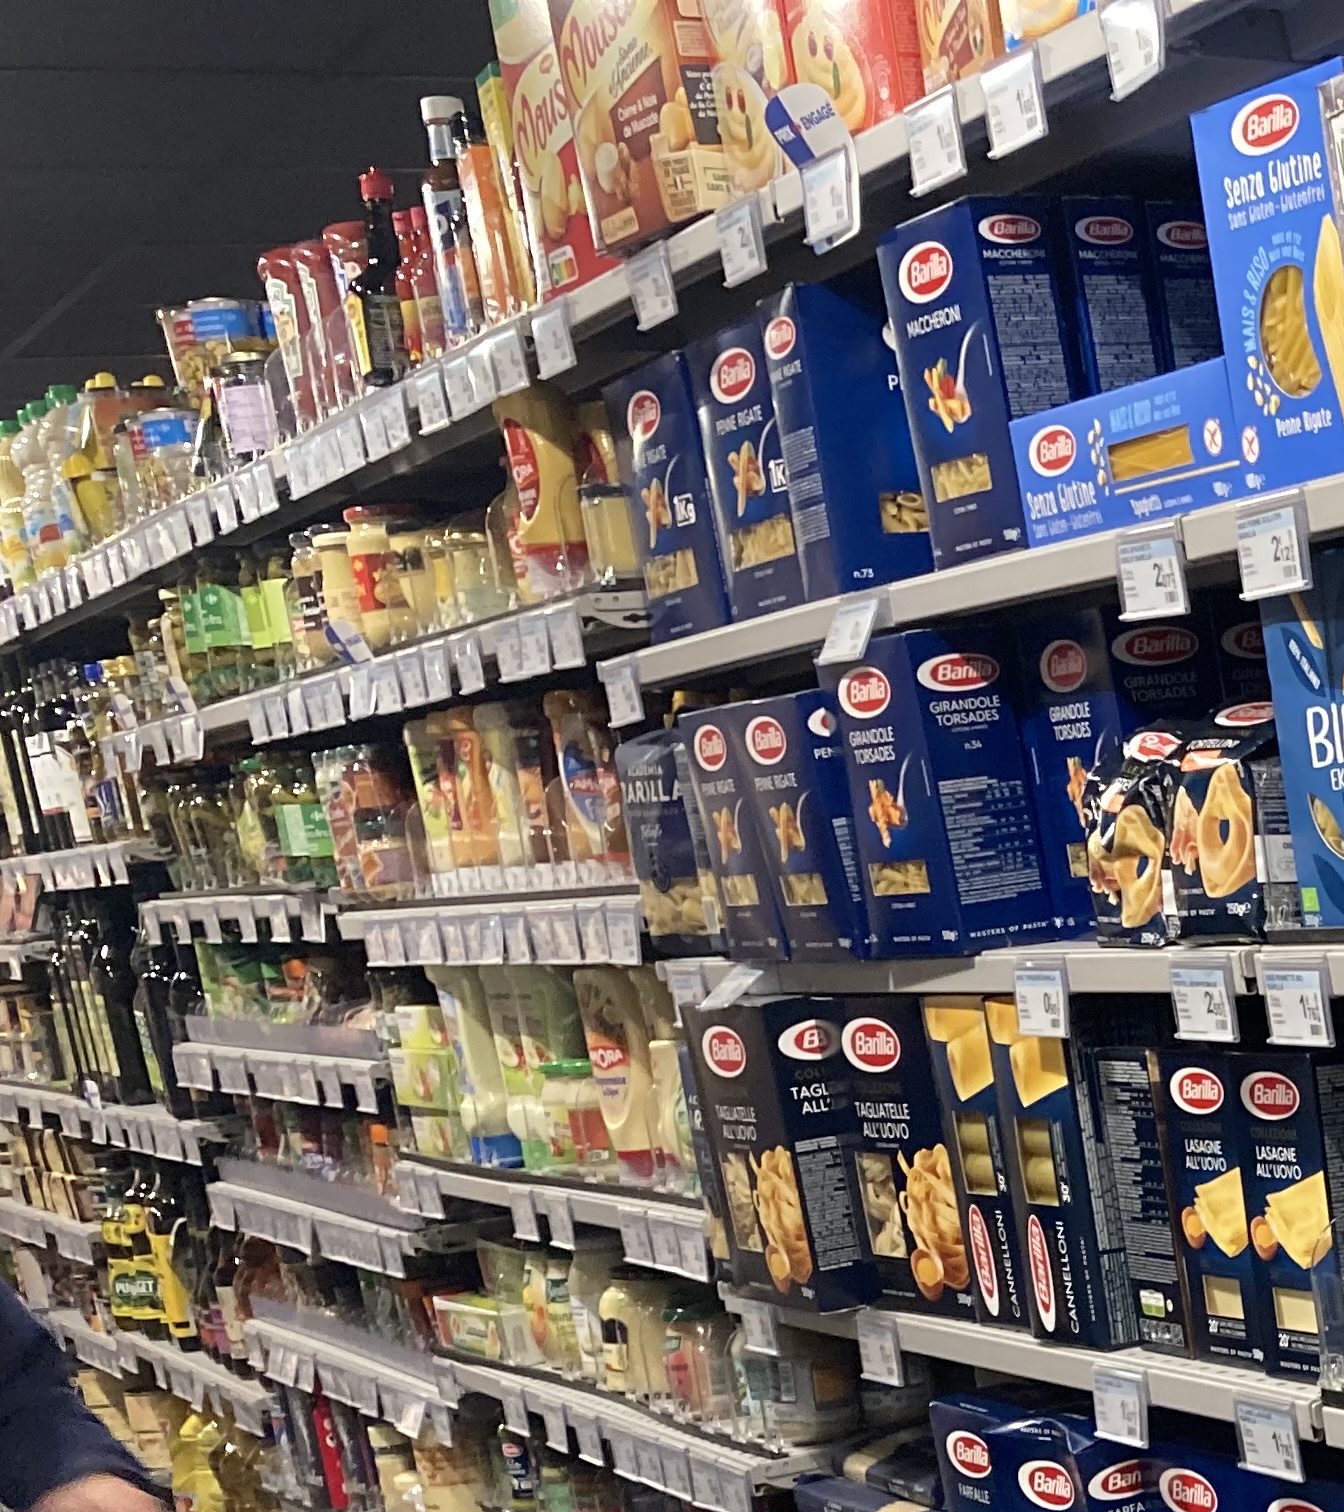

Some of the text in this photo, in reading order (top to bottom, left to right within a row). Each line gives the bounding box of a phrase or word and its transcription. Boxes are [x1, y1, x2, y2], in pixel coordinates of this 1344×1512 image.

[1245, 102, 1295, 149] Barilla
[1224, 151, 1323, 211] Senza Glutine
[993, 221, 1037, 238] Barilla
[1084, 222, 1126, 238] Barilla
[910, 259, 949, 286] Barilla
[906, 304, 962, 338] MACCHERONI
[717, 361, 750, 390] Barilla
[1276, 409, 1333, 438] Penne Rigate
[1037, 437, 1073, 464] Barilla
[935, 660, 994, 683] Barilla
[850, 677, 887, 705] Barilla
[928, 695, 1001, 717] GIRANDOLE
[935, 708, 1000, 728] TORSADES
[752, 727, 783, 755] Barilla
[848, 724, 897, 748] GIRANDOLE
[853, 745, 896, 765] TORSADES
[711, 1040, 742, 1063] Barilla
[855, 1033, 897, 1057] Barilla
[1183, 1079, 1219, 1103] Barilla
[1253, 1084, 1294, 1107] Barilla
[855, 1102, 911, 1121] TAGLIATELLE
[863, 1121, 910, 1140] ALL'UOVO
[1184, 1140, 1223, 1156] LASAGNE
[1255, 1145, 1298, 1164] LASAGNE
[1185, 1155, 1227, 1172] ALL'UOVO
[1256, 1162, 1302, 1180] ALL'UOVO
[1030, 1225, 1055, 1315] Barilla
[1055, 1219, 1080, 1335] CANNELLONI
[953, 1443, 990, 1473] Barilla
[1028, 1471, 1073, 1499] Barilla
[1171, 1480, 1215, 1509] Barilla
